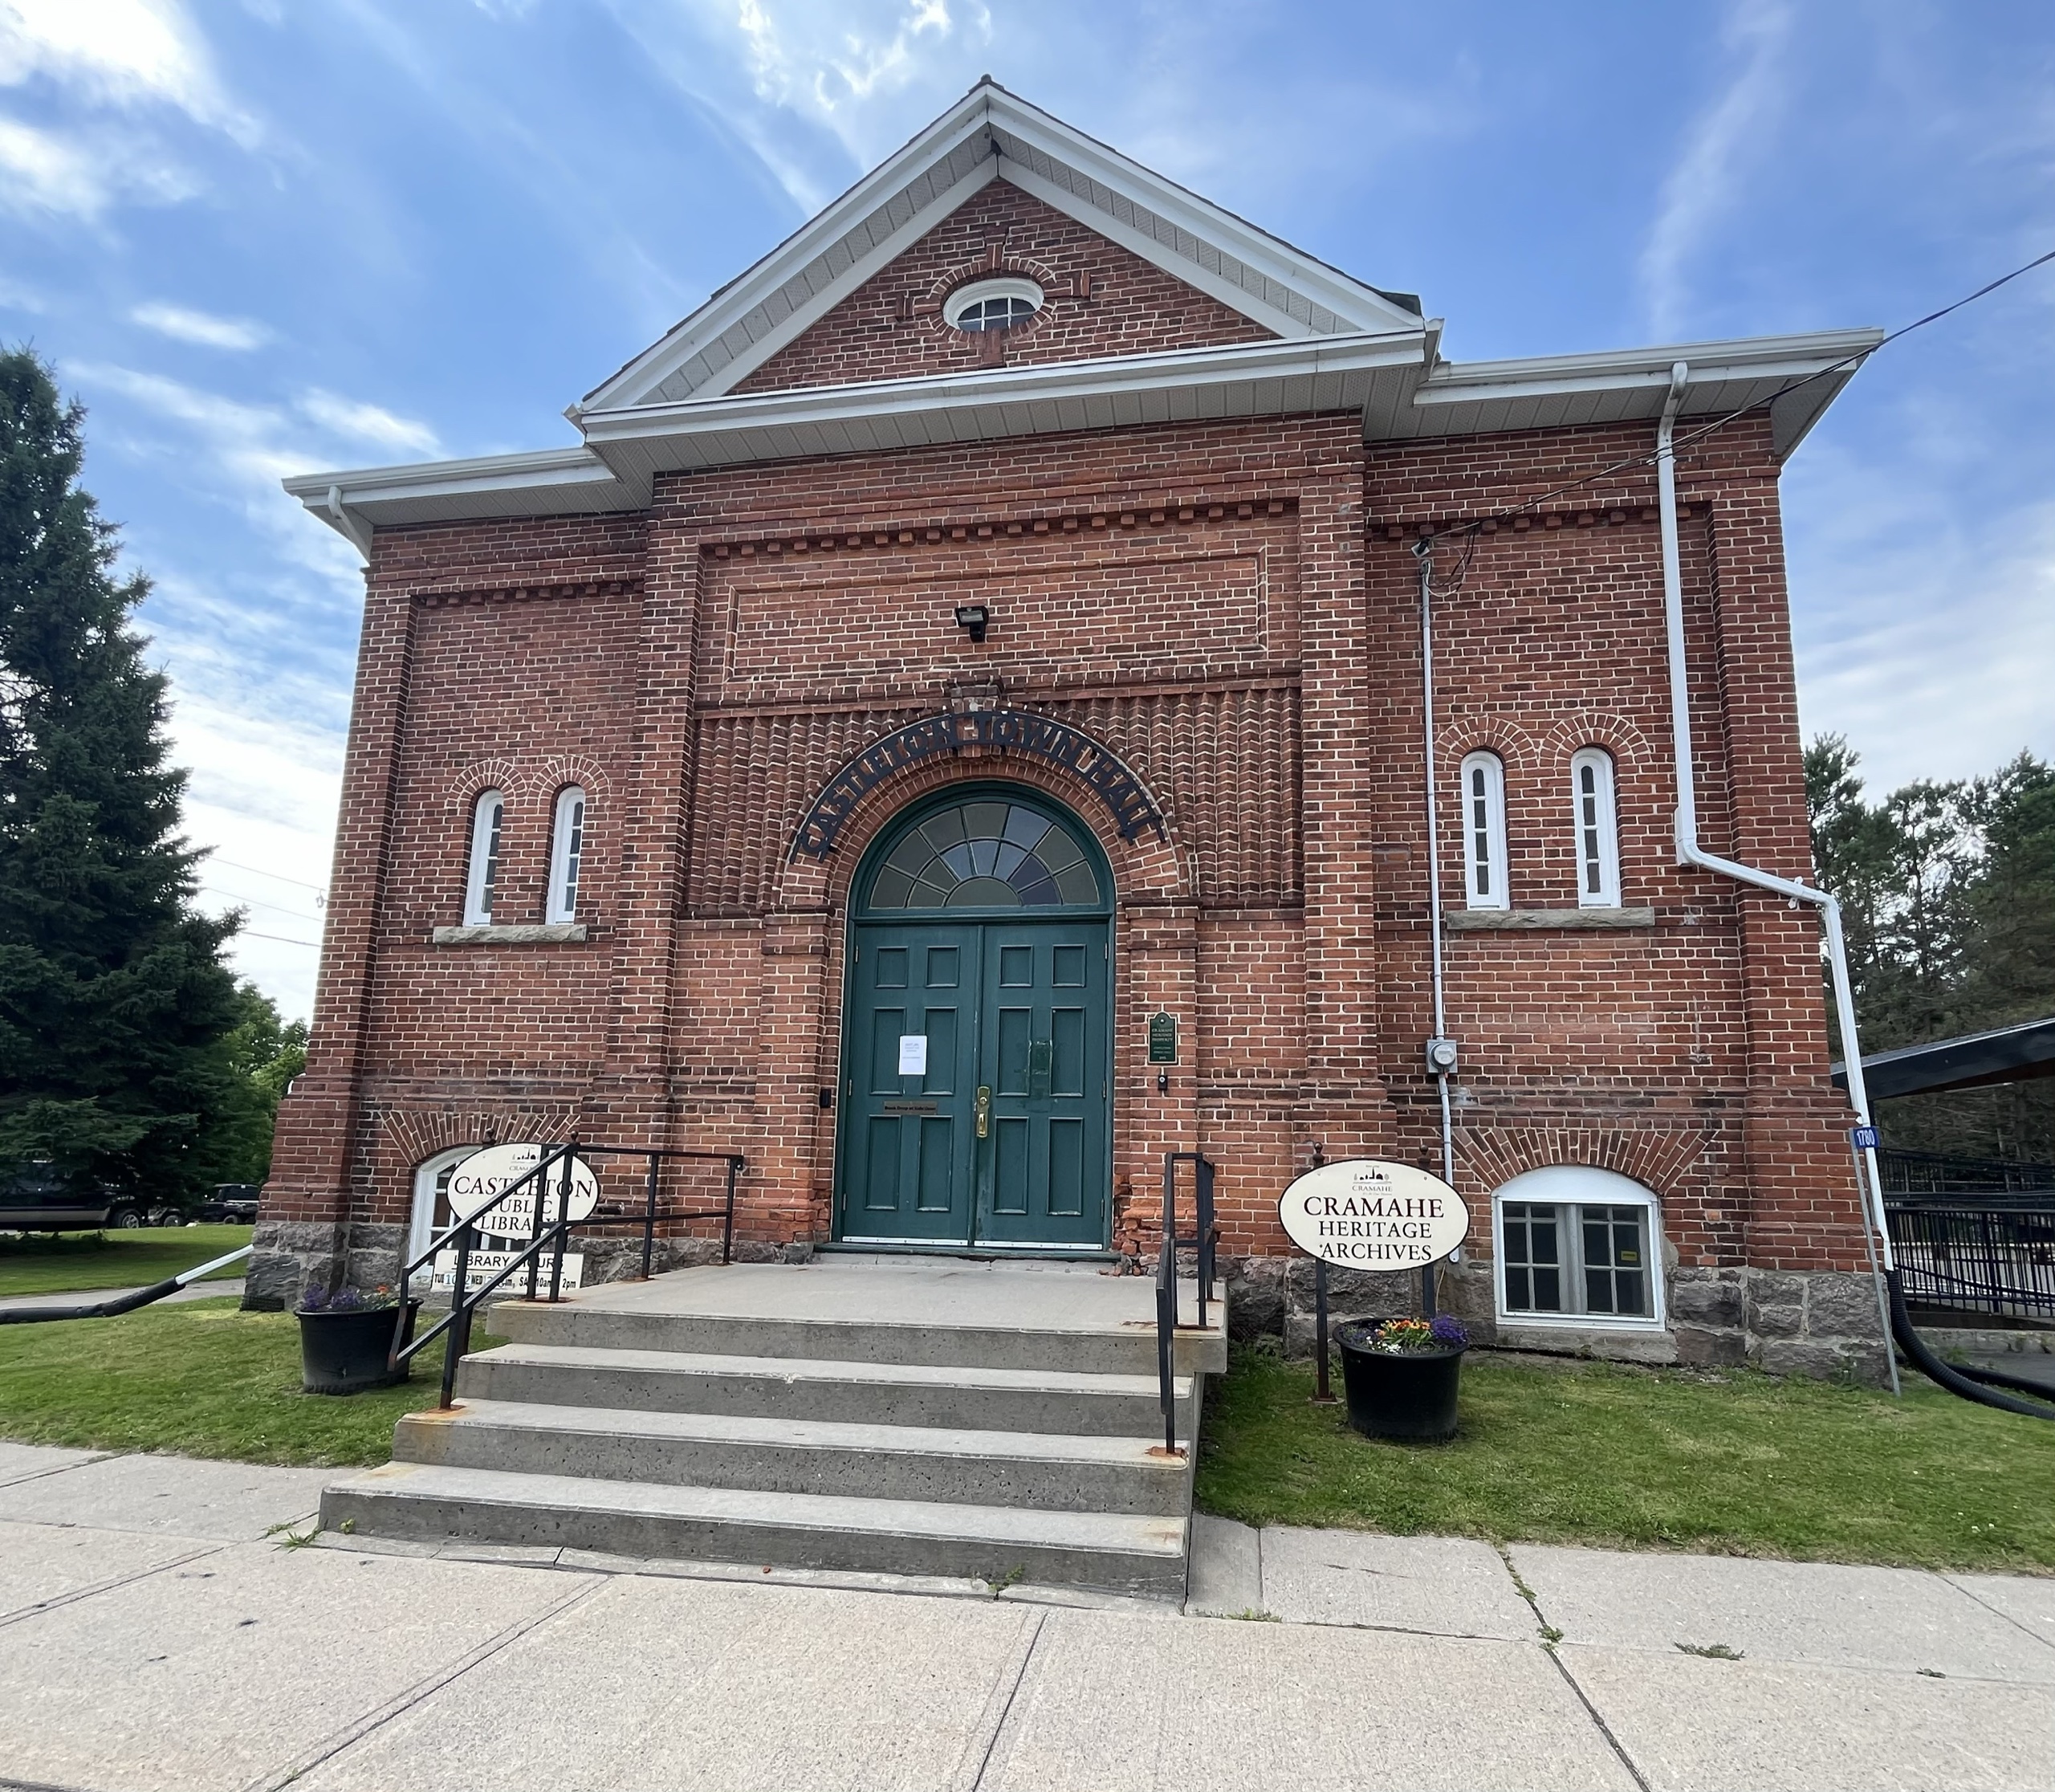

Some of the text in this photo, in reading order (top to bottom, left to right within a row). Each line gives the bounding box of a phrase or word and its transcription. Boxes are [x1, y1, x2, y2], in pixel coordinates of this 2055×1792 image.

[801, 712, 1157, 854] CASTLETON TOWN HALL
[1857, 1129, 1875, 1146] 1780
[490, 1199, 553, 1214] UBLC
[1304, 1196, 1444, 1218] CRAMAHE
[1319, 1220, 1432, 1239] HERITAGE
[1320, 1242, 1432, 1261] ARCHIVES
[454, 1254, 510, 1268] LBRARY
[562, 1277, 577, 1290] 2pm
